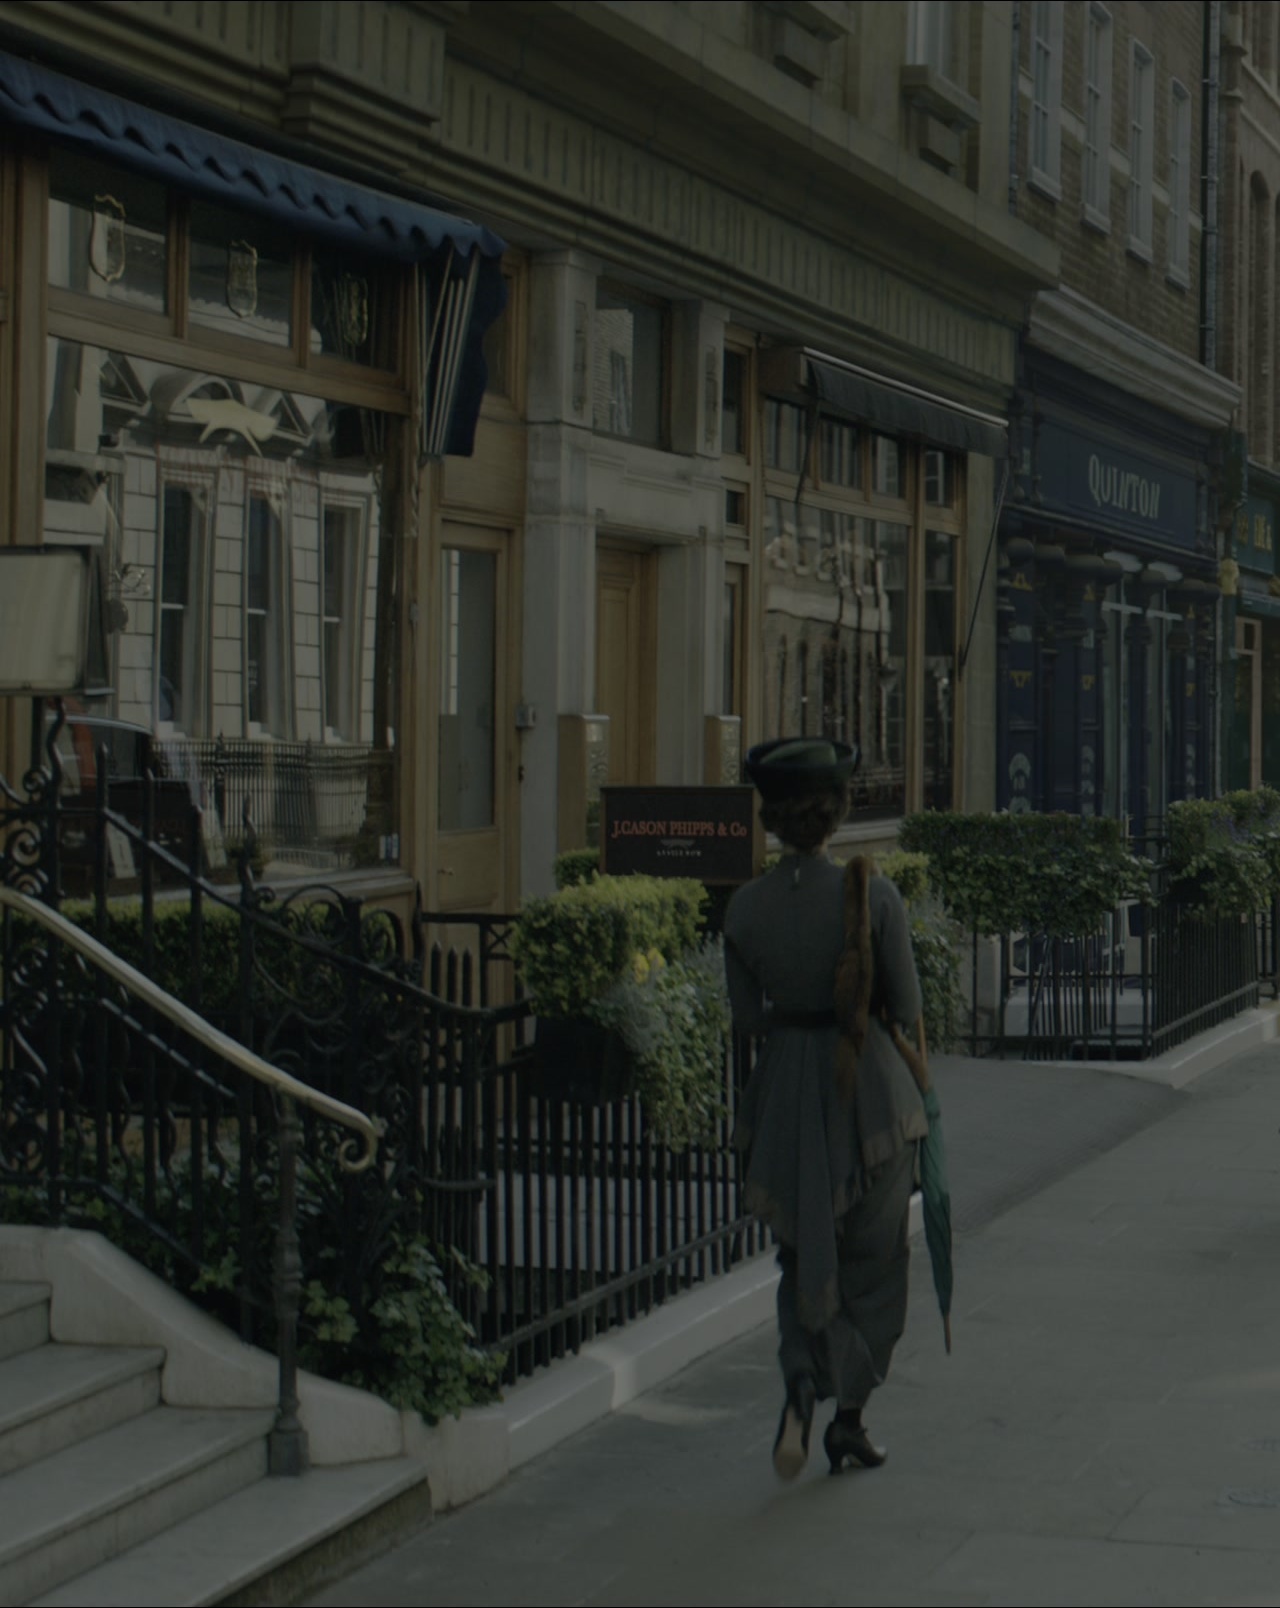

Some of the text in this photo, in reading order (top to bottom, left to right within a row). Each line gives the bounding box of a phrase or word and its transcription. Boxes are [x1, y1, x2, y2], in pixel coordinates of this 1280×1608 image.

[1088, 453, 1160, 519] QUINTON
[670, 821, 714, 836] PHIPPS
[717, 822, 728, 837] &
[730, 822, 748, 837] Co
